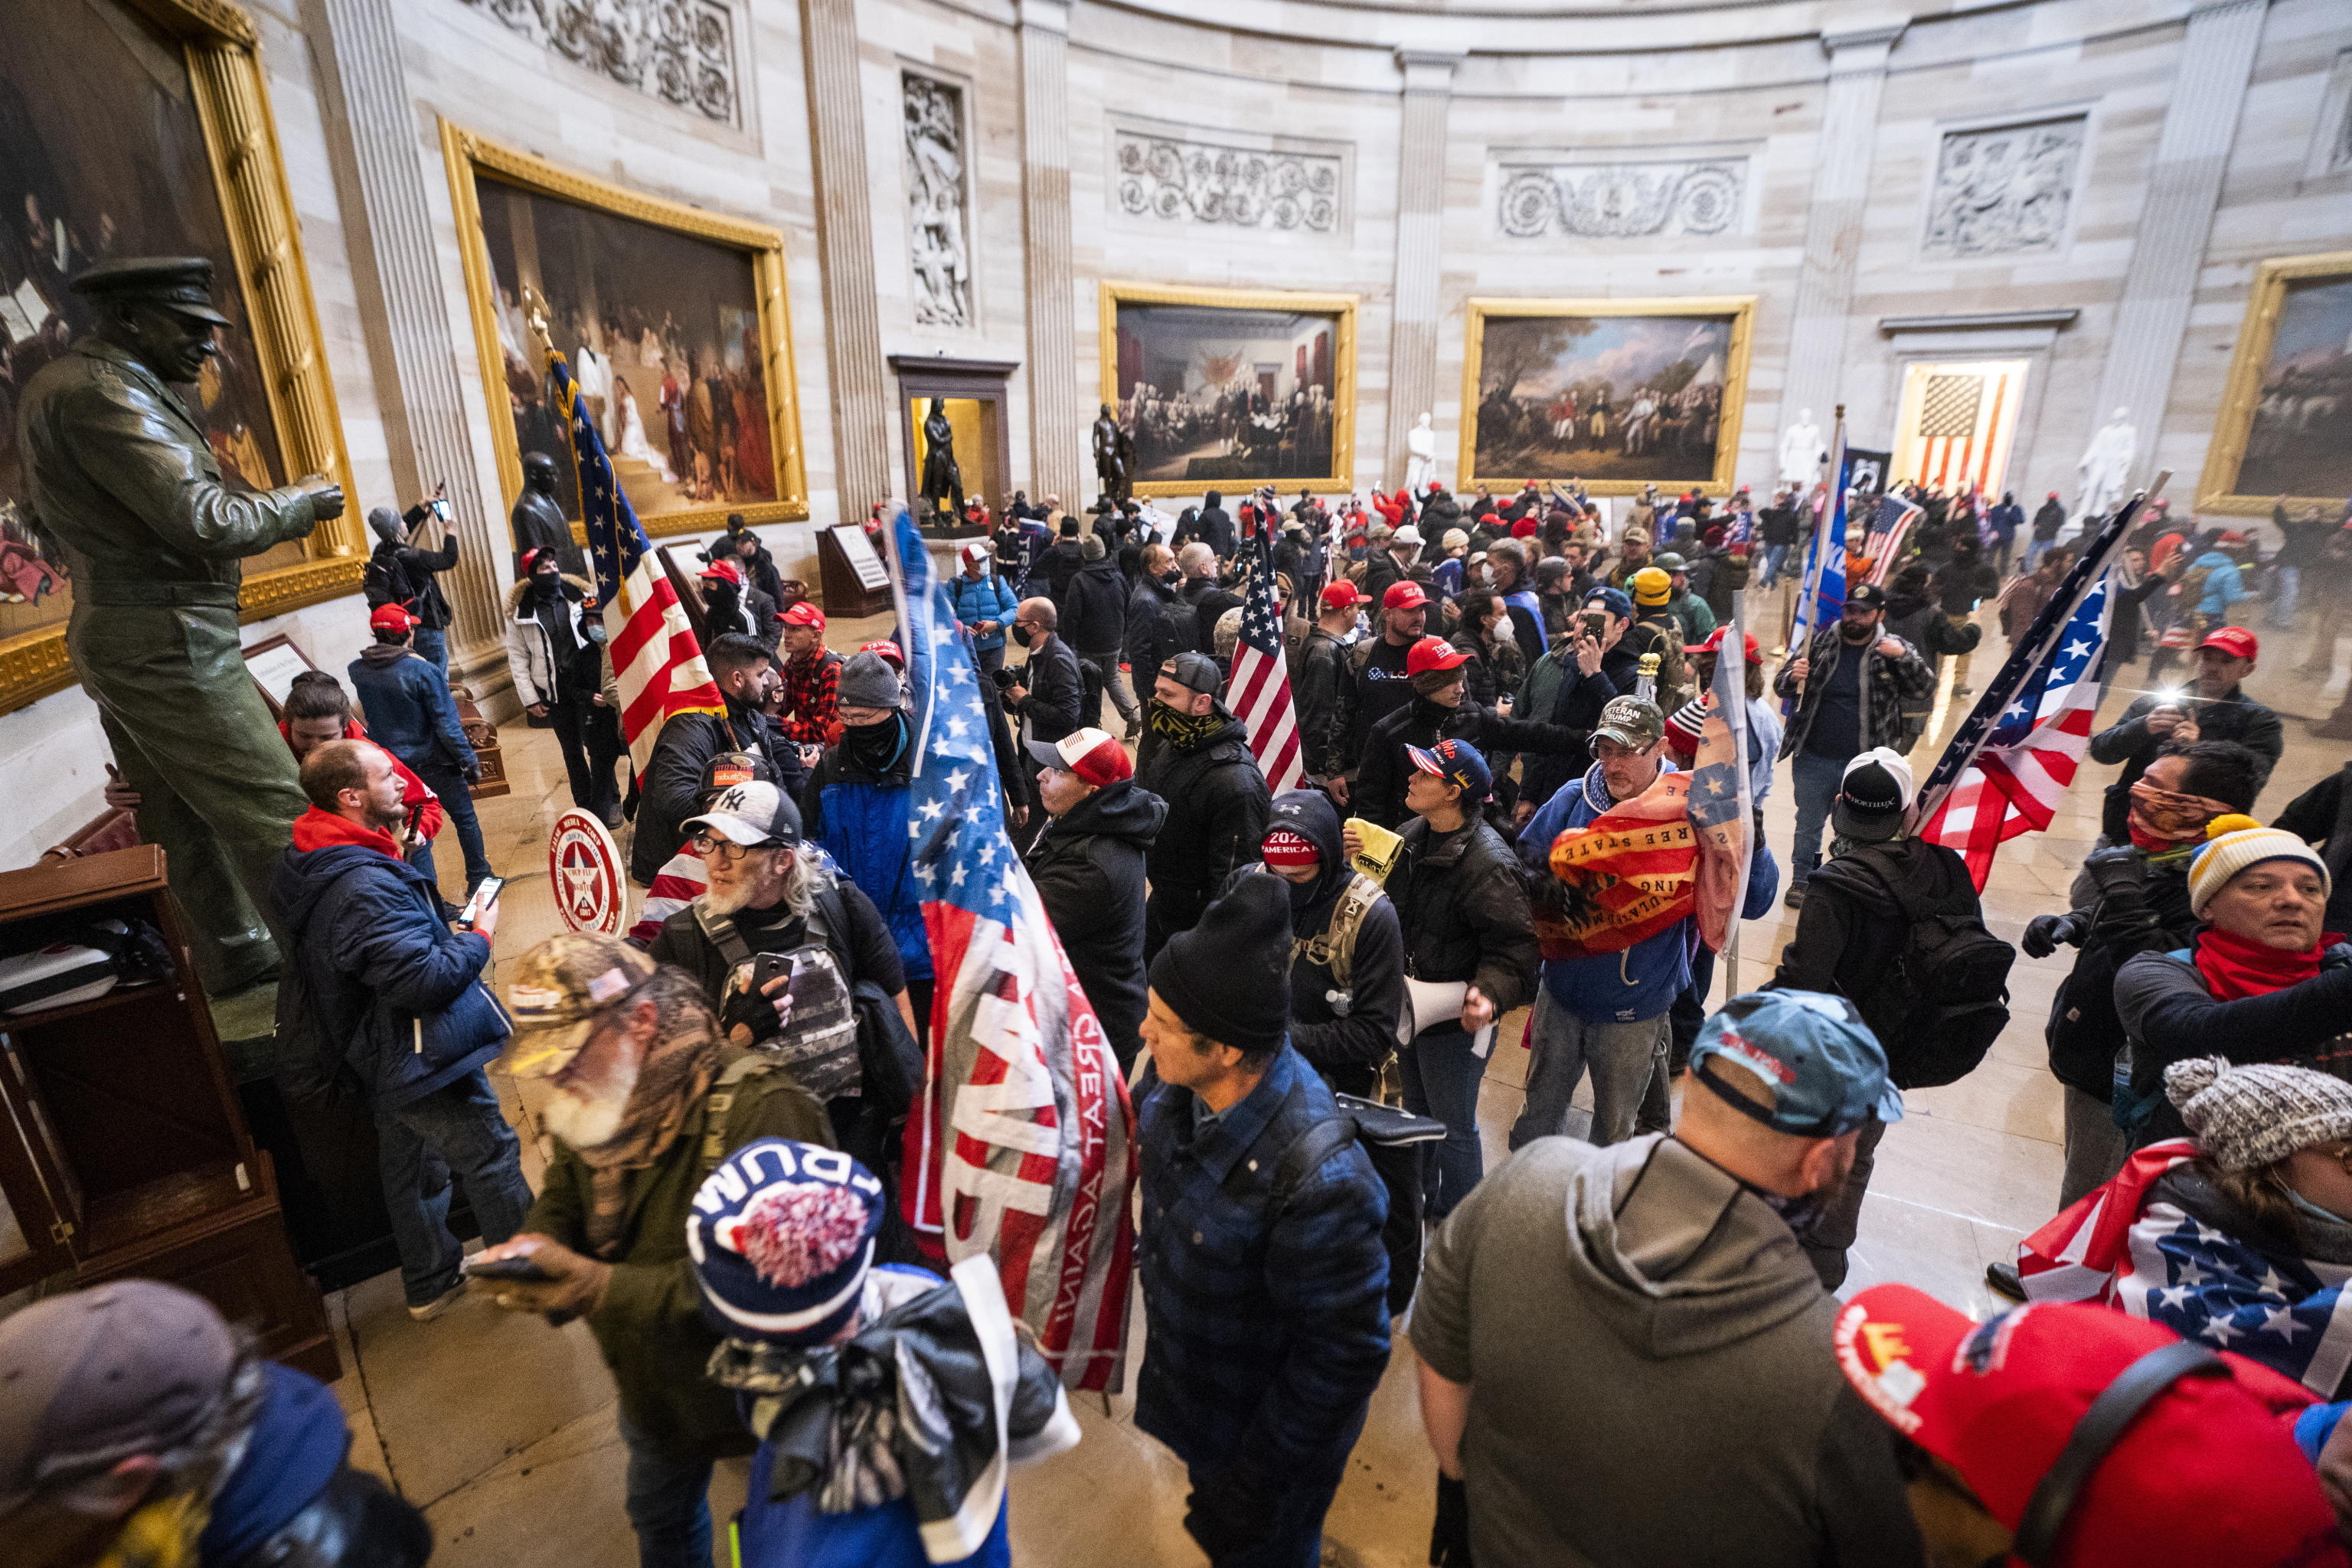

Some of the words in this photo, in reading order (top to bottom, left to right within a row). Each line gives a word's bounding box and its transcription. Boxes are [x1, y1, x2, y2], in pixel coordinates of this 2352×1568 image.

[1605, 706, 1641, 719] VETERAN
[1606, 714, 1632, 723] TRUMP
[720, 789, 746, 812] NY
[1851, 796, 1896, 808] HORTILUX
[564, 817, 580, 828] MEDIA
[1264, 845, 1311, 854] AMERICA
